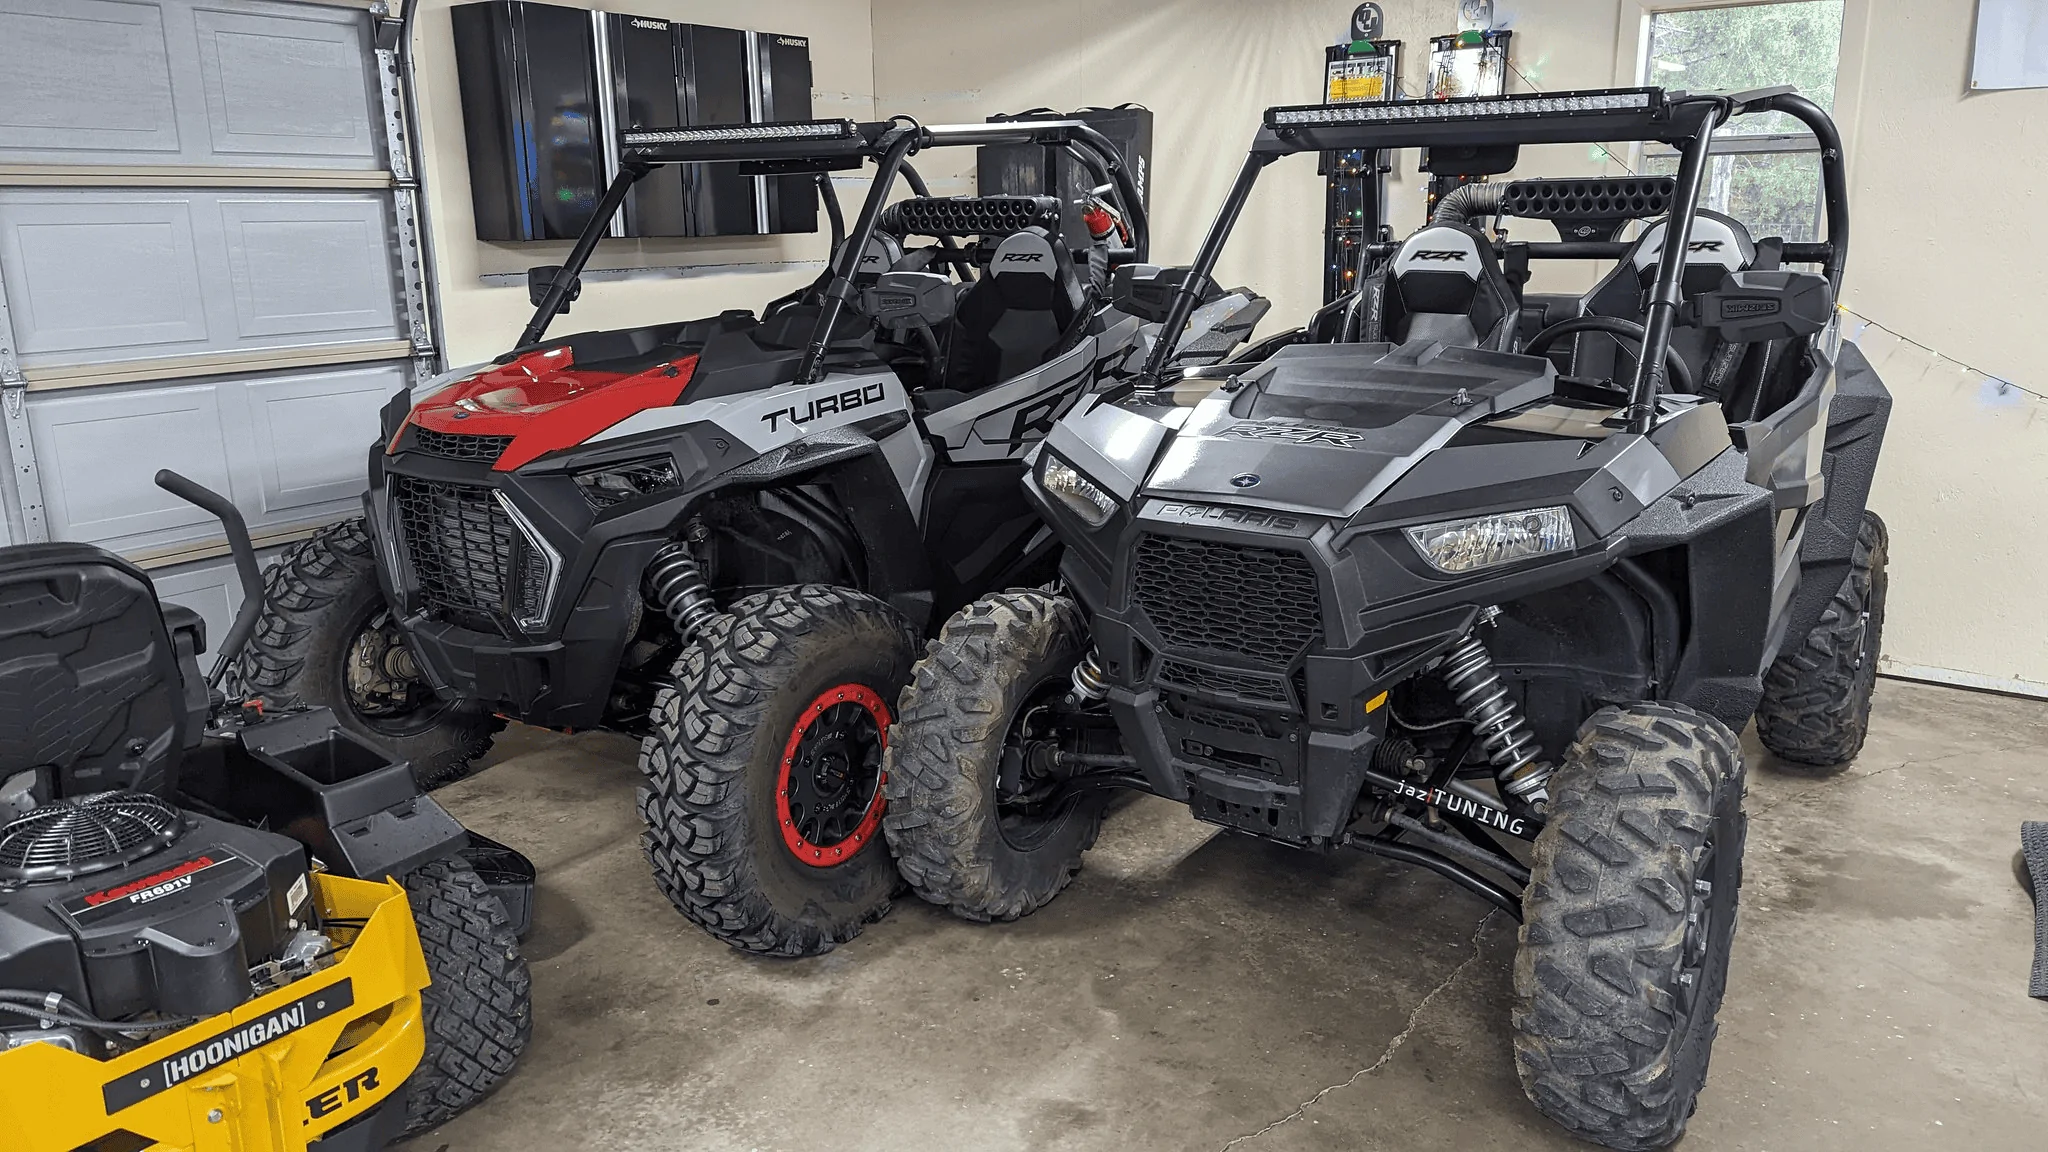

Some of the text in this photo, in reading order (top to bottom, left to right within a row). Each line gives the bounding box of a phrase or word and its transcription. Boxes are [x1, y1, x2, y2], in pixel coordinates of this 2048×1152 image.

[640, 20, 667, 31] HUSKY
[784, 38, 807, 47] HUSKY
[1136, 154, 1146, 206] AMPS
[1001, 253, 1044, 263] RZR
[1408, 250, 1469, 262] RZR
[1370, 286, 1382, 322] RZR
[761, 382, 886, 433] TURBO
[1213, 424, 1366, 449] RZR
[1156, 503, 1301, 530] POLARIS
[129, 876, 192, 904] FR691V
[303, 1066, 380, 1127] ER
